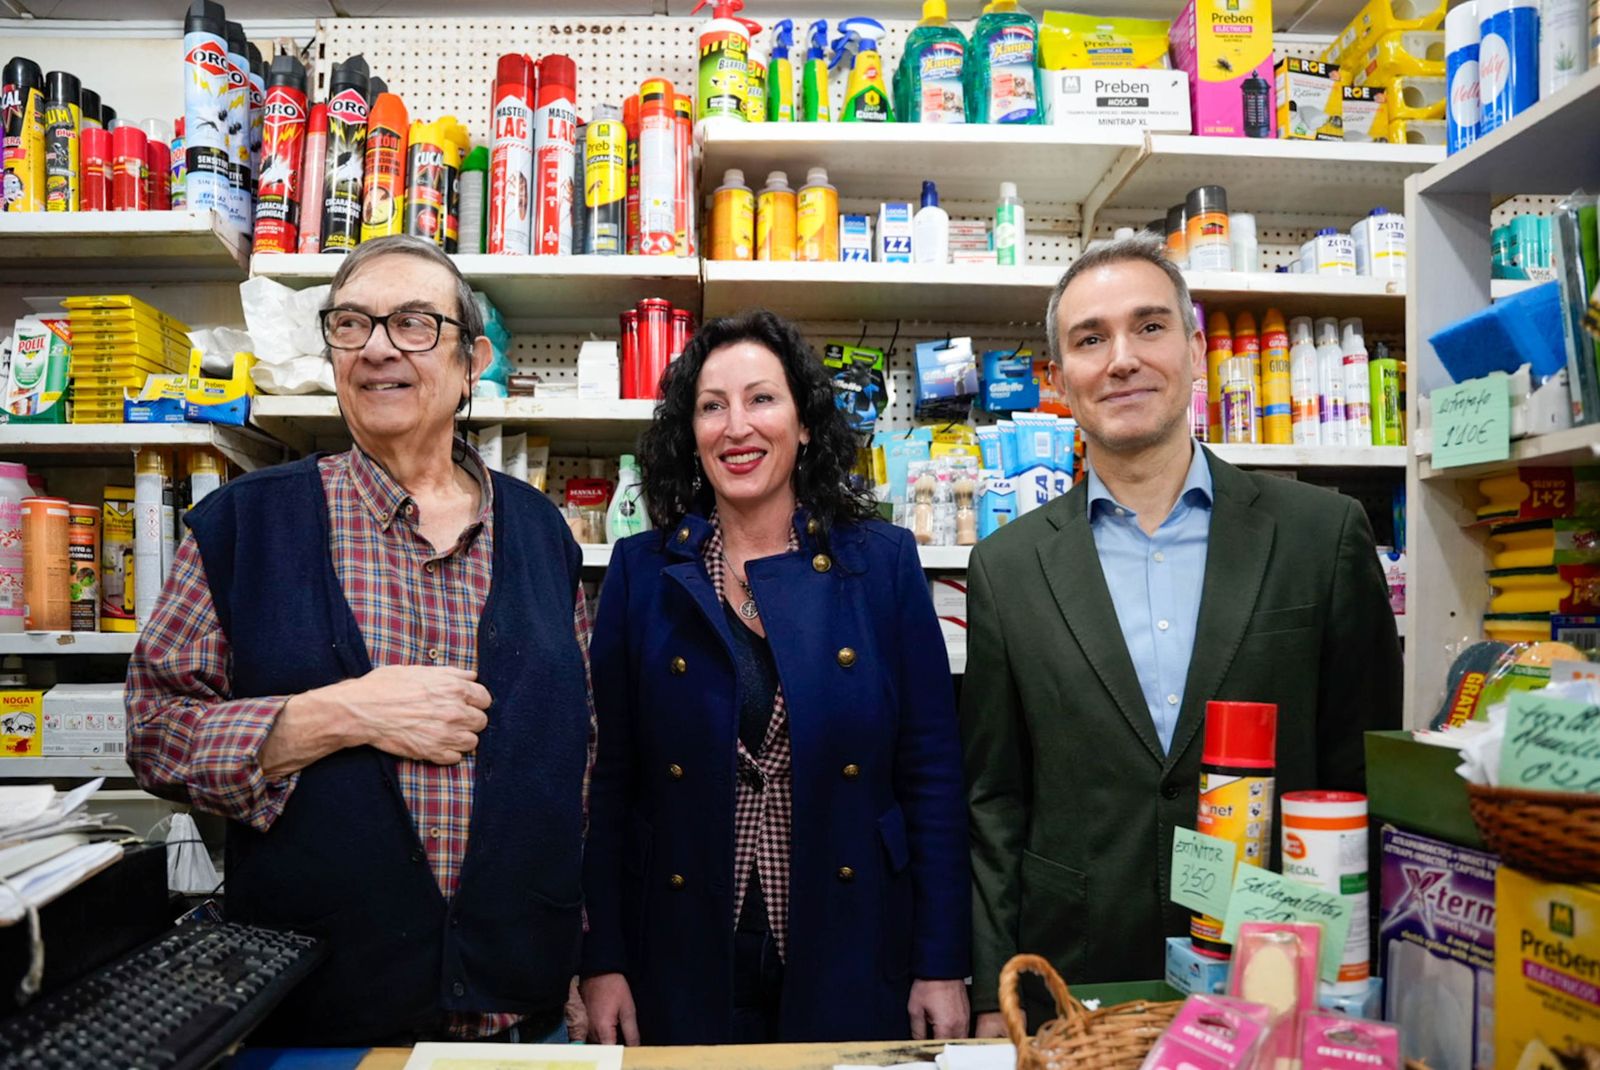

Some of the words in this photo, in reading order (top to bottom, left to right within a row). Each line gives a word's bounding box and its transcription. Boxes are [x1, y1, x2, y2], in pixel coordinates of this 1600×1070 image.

[1211, 12, 1254, 24] Preben
[193, 51, 228, 71] ORO
[1301, 58, 1326, 75] ROE
[1095, 80, 1150, 93] Preben
[1343, 87, 1371, 98] ROE
[332, 100, 368, 118] ORO
[1107, 98, 1138, 106] MOSCAS
[46, 108, 70, 126] UM
[264, 103, 297, 117] ORO
[496, 117, 527, 139] LAC
[1098, 118, 1137, 126] MINITRAP
[1139, 118, 1148, 126] XL
[55, 129, 77, 139] plus
[548, 119, 576, 145] LAC
[415, 152, 443, 166] CUCA
[886, 237, 910, 252] ZZ
[18, 337, 46, 353] POLIL
[1035, 474, 1049, 505] EA
[3, 696, 35, 704] NOGAT
[1451, 672, 1486, 727] GRATIS
[1180, 864, 1216, 892] 3'50
